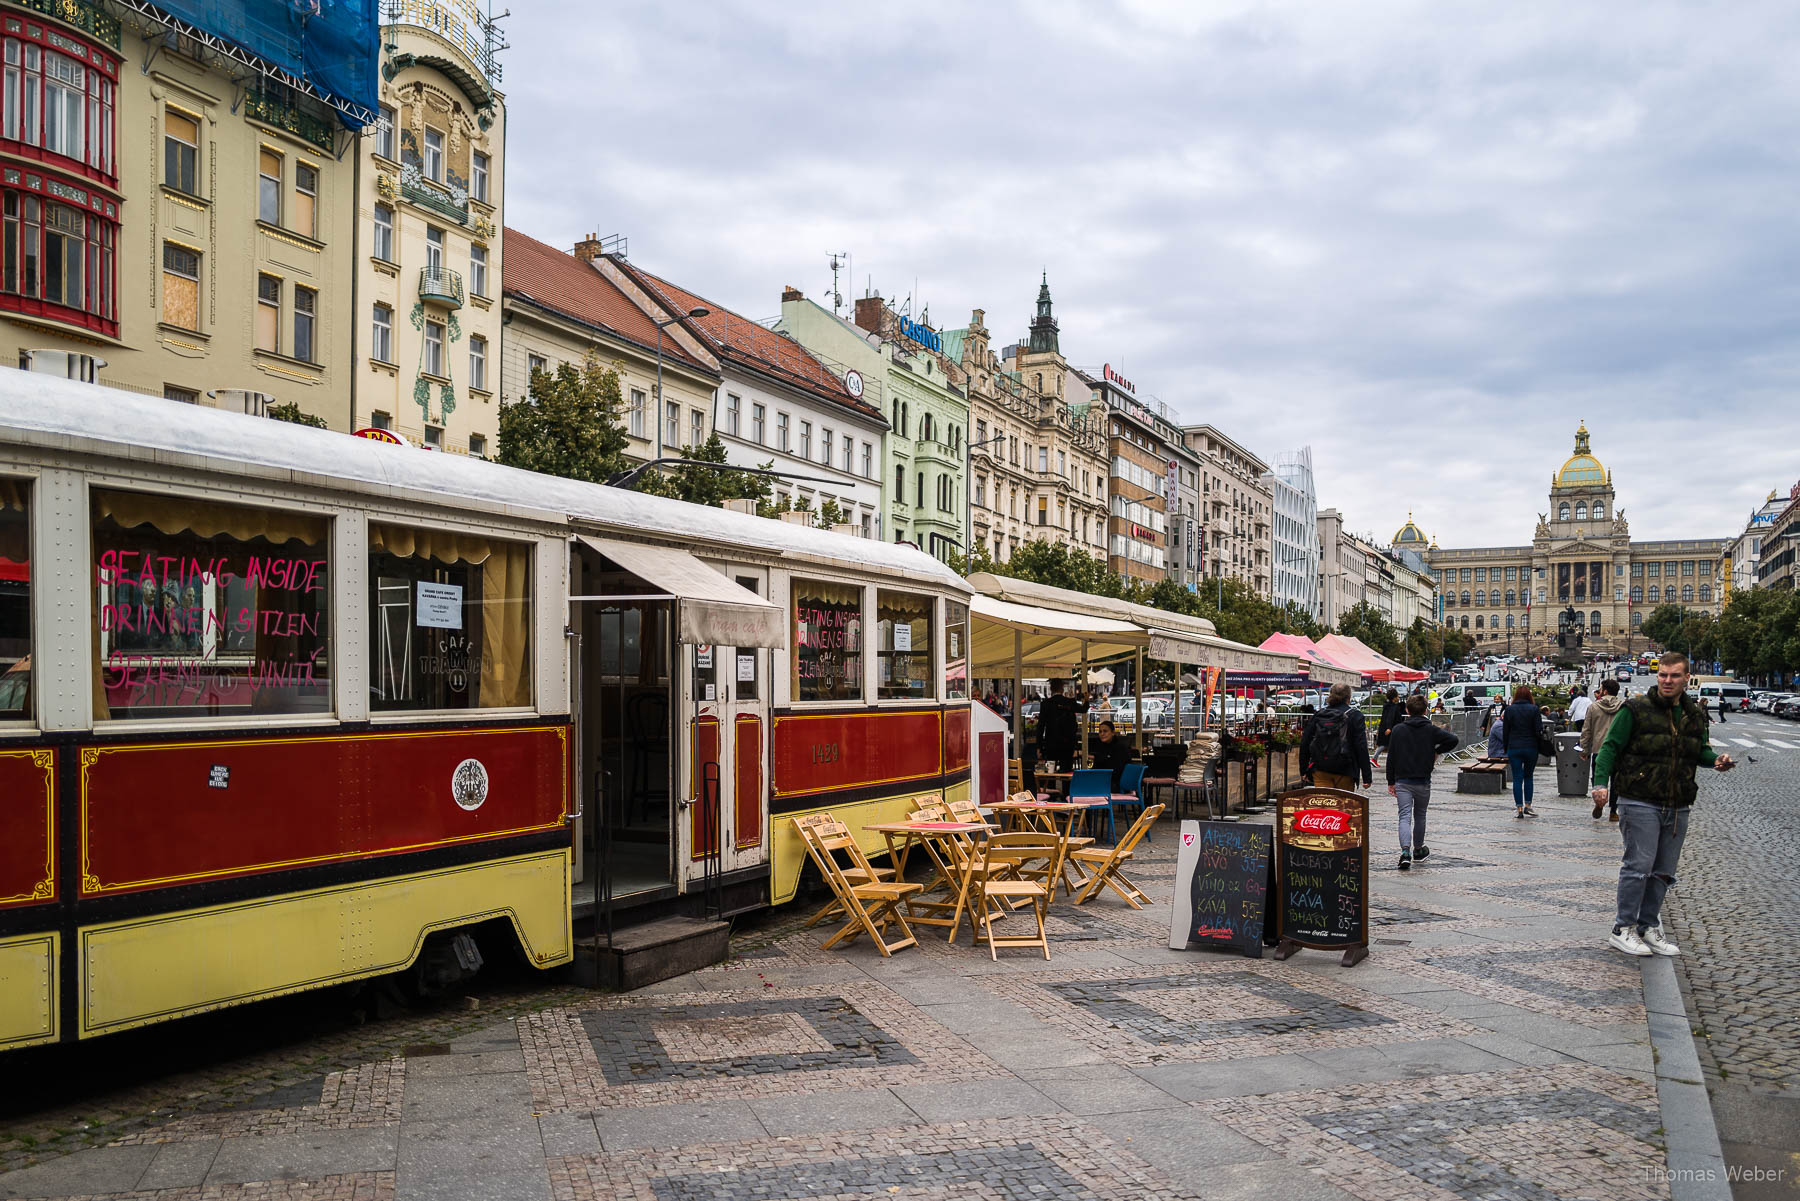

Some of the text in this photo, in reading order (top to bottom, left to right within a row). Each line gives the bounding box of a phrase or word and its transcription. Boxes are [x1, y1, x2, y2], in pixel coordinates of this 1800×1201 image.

[900, 315, 940, 352] CASINO
[1110, 370, 1136, 394] RAMADA
[97, 550, 327, 593] SEATING INSIDE
[101, 604, 320, 636] DRINNEN SITZEN
[440, 636, 474, 654] CAFE
[813, 743, 839, 764] 1429
[1308, 798, 1338, 806] Coca-Cola
[1300, 813, 1342, 830] Coca-Cola
[1203, 828, 1243, 848] APEROL
[1287, 871, 1323, 888] PANINI
[1198, 895, 1226, 914] KÁVA
[1290, 888, 1324, 910] KÁVA
